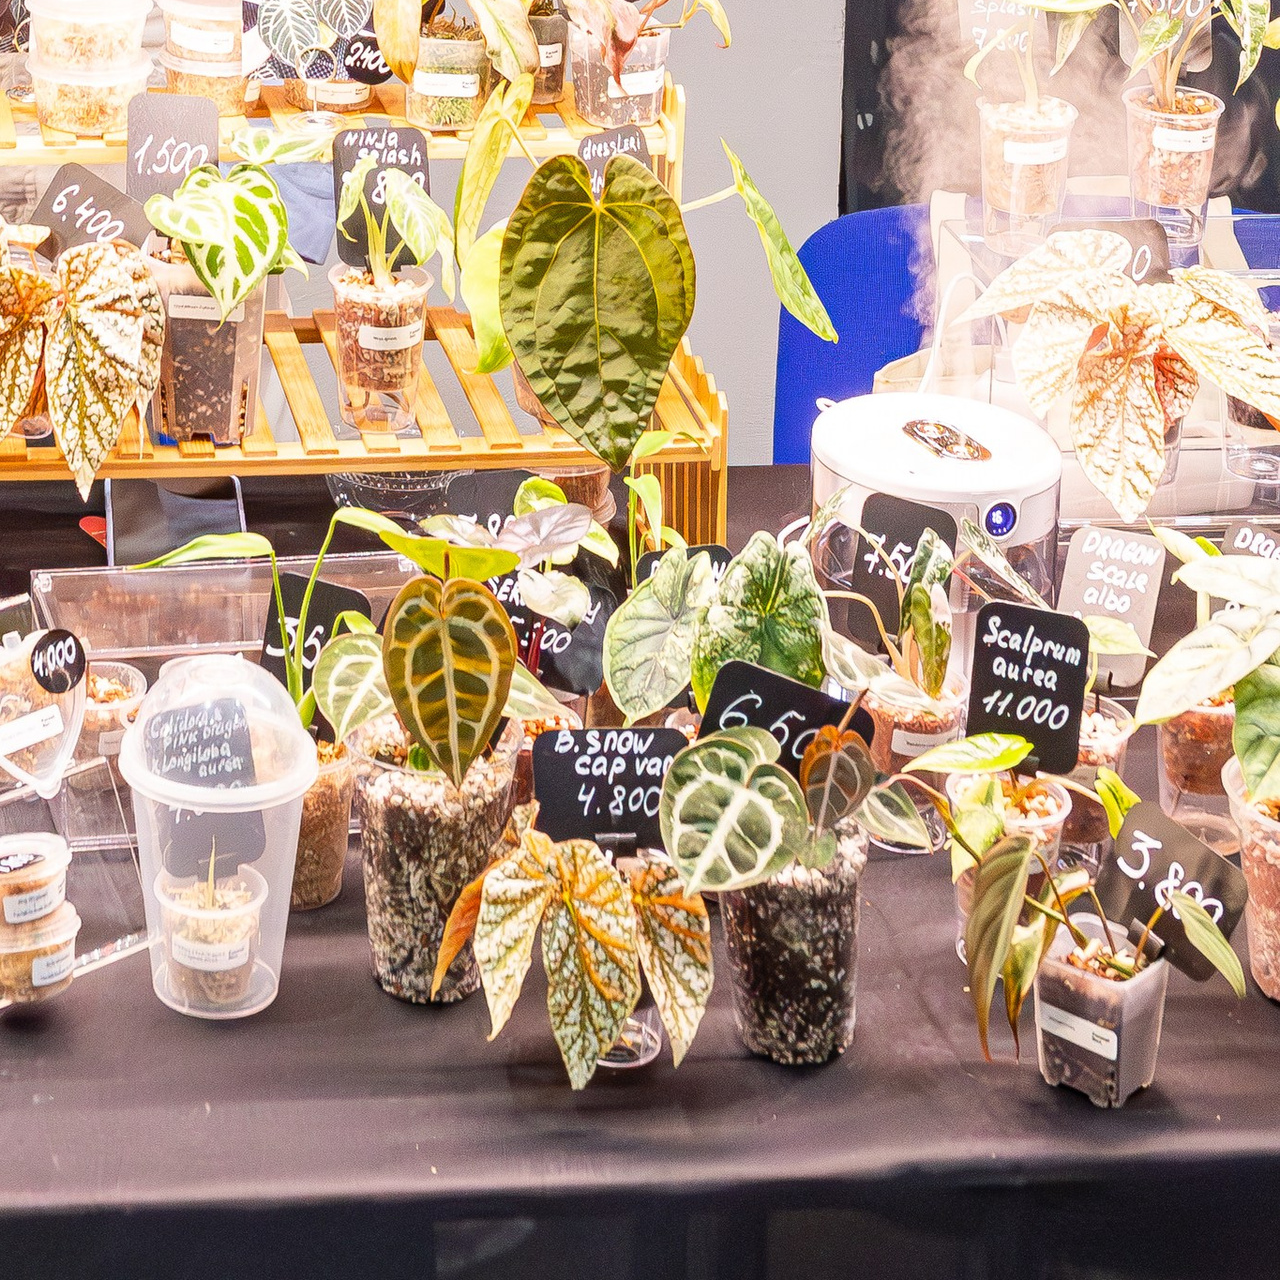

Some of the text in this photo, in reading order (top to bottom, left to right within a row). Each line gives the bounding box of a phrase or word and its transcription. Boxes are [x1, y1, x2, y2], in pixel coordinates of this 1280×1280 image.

[134, 133, 209, 176] 1.500
[52, 184, 125, 243] 6.400
[1083, 586, 1131, 614] albo
[33, 635, 77, 678] 4.000
[982, 615, 1082, 666] Scalprum
[992, 656, 1059, 692] aurea
[982, 689, 1070, 730] 11.000
[574, 755, 626, 785] cap
[577, 783, 661, 818] 4.800
